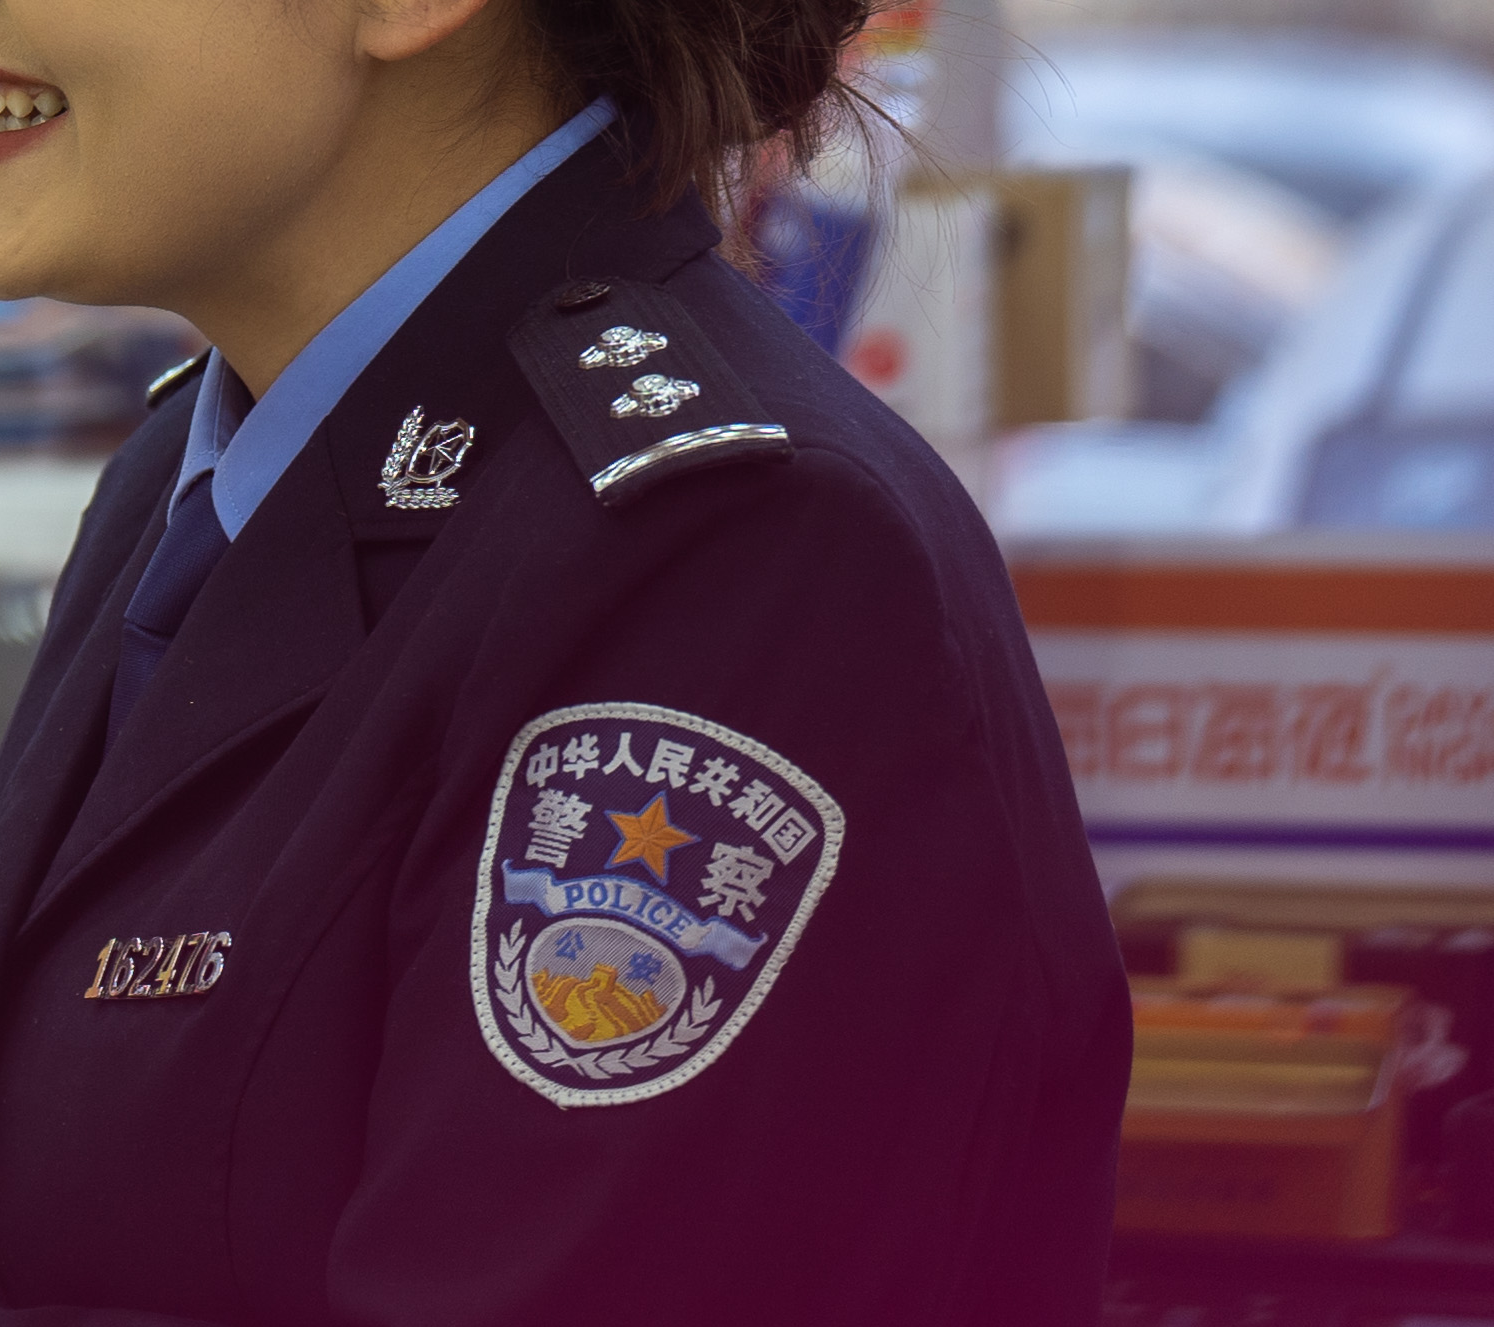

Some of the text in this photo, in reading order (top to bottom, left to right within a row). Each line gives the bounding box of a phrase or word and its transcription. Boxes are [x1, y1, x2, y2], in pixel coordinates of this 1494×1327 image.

[524, 730, 819, 867] 中华人民共和国
[563, 880, 693, 941] POLICE
[84, 930, 233, 1000] 162476
